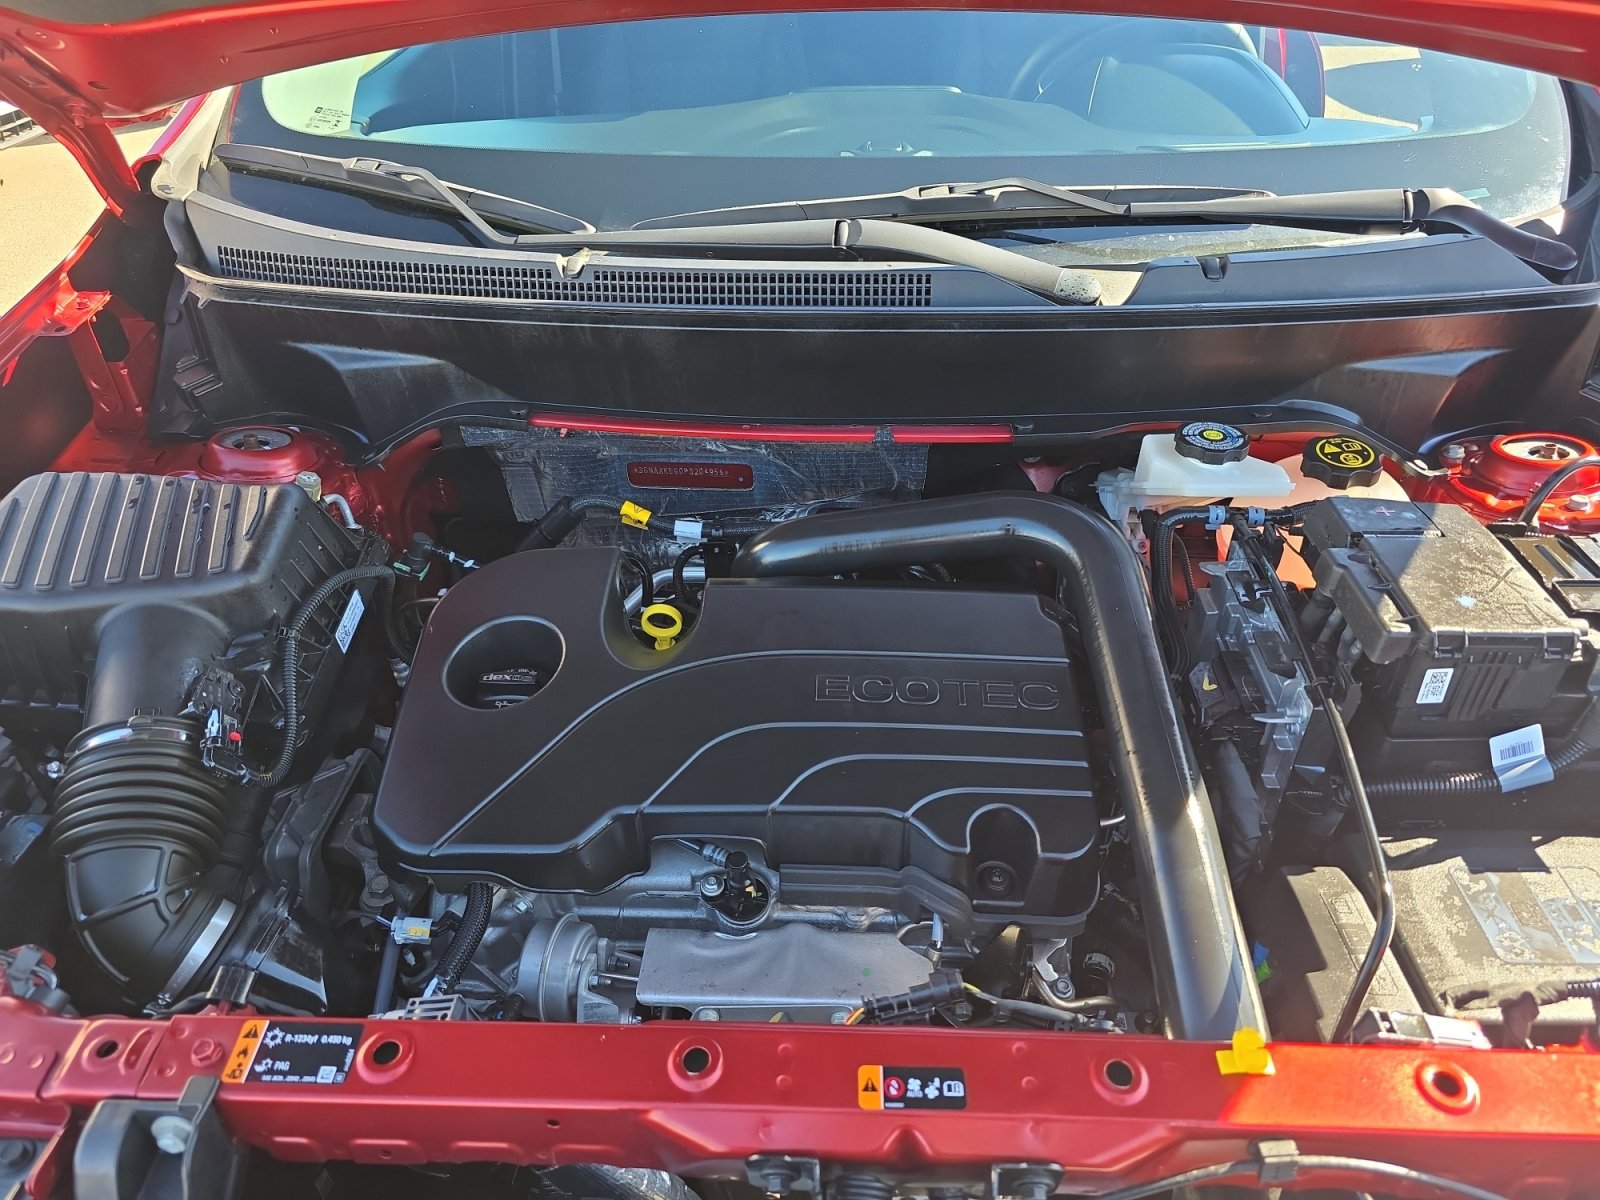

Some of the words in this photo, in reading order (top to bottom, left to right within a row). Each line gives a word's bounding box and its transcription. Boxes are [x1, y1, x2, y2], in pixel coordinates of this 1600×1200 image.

[815, 674, 1060, 710] ECOTEC
[342, 1037, 352, 1046] kg
[274, 1061, 290, 1071] PAG
